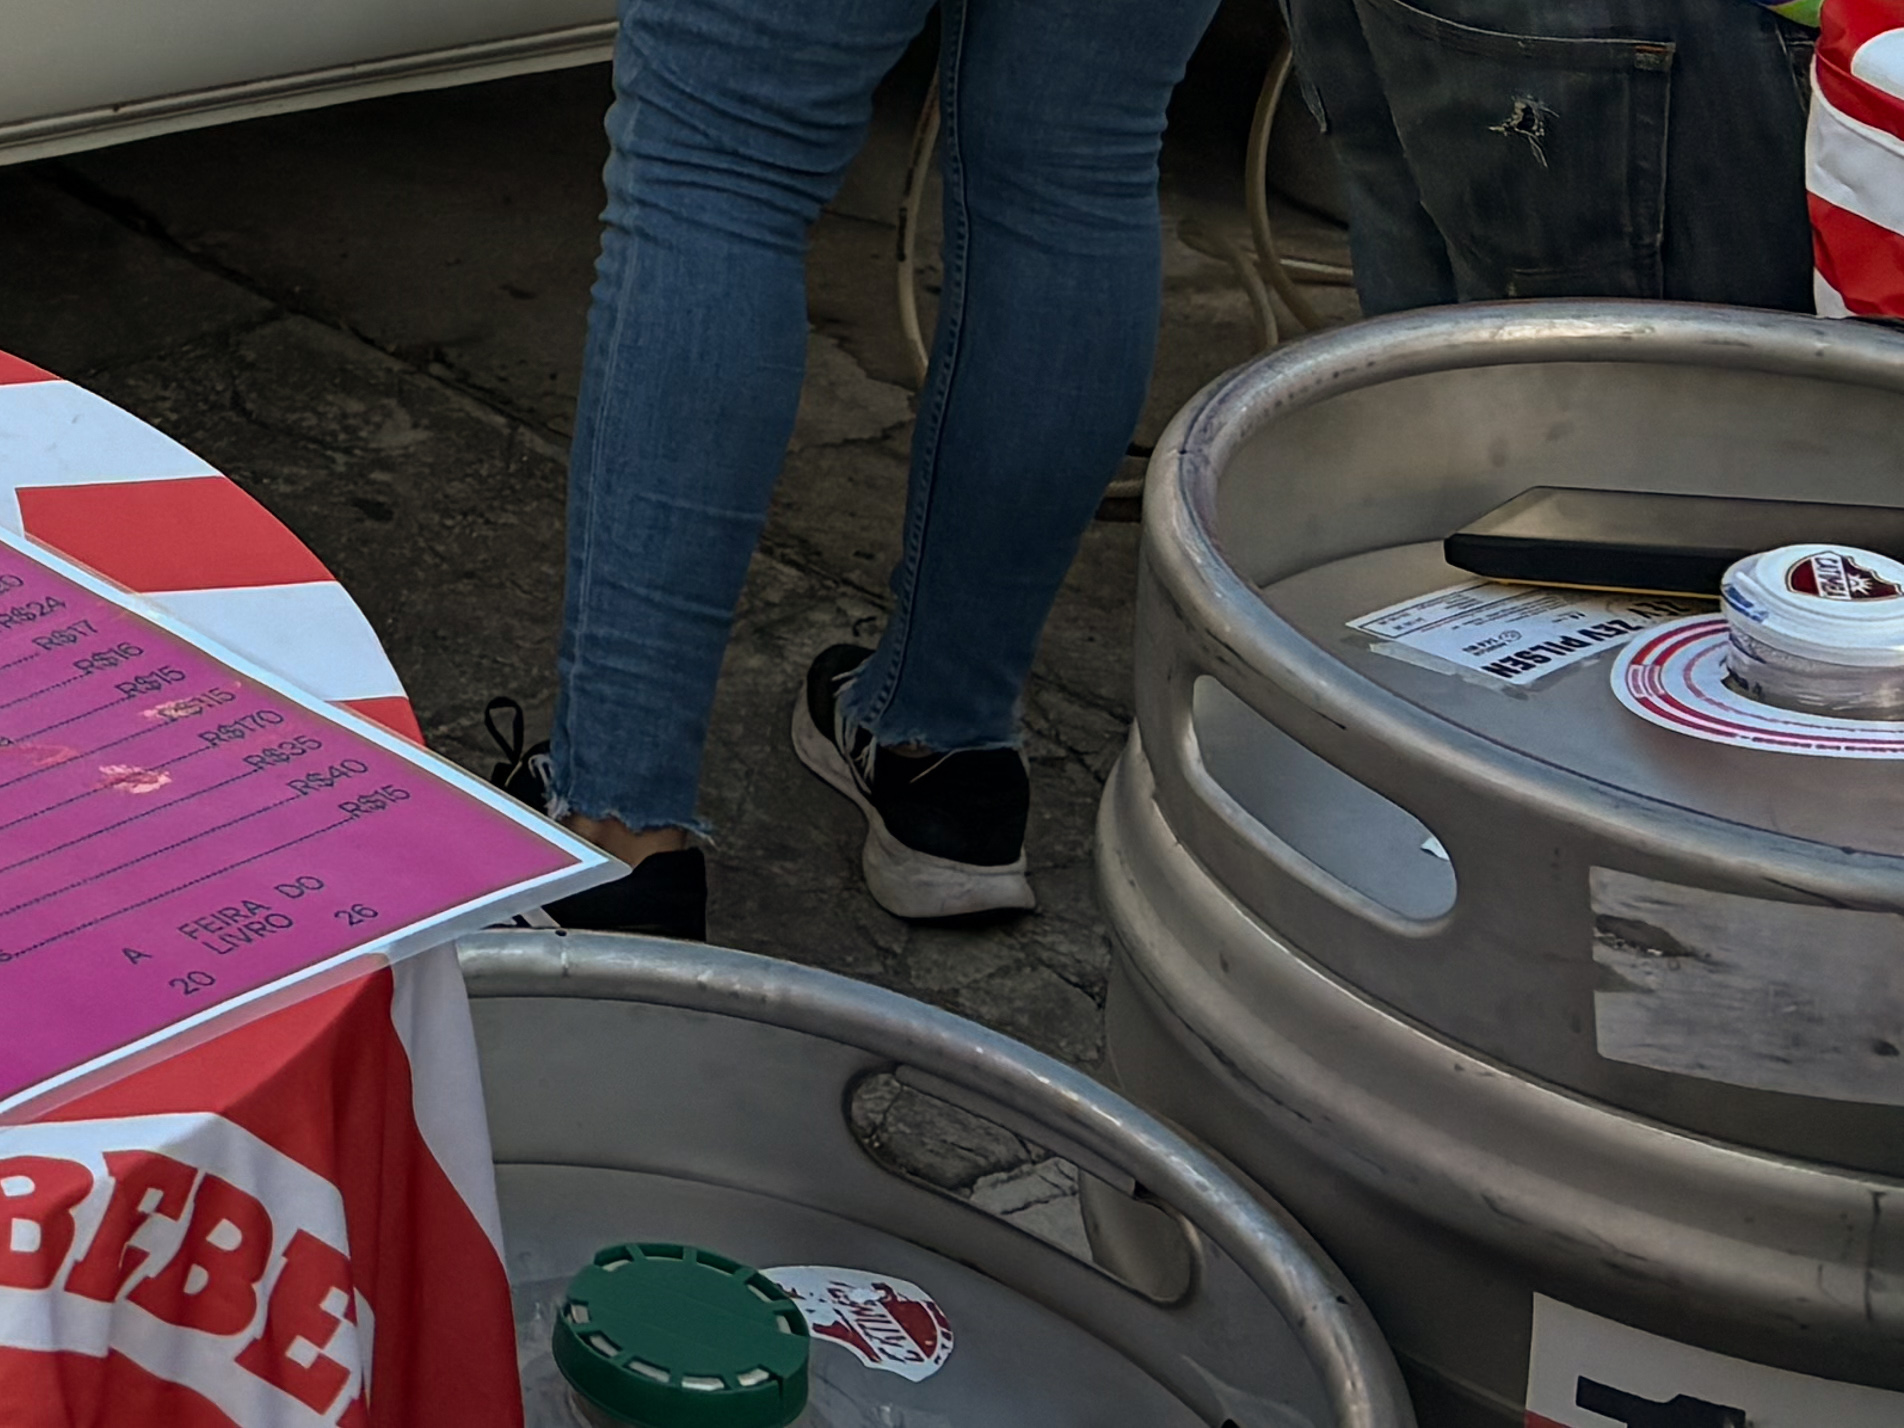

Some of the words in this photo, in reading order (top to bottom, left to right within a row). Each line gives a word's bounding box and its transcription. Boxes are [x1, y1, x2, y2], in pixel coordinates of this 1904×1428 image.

[31, 619, 99, 652] R$17
[73, 642, 145, 675] R$16
[1480, 634, 1580, 679] PILSEN
[114, 665, 186, 698] R$15
[198, 709, 285, 749] R$170
[243, 735, 324, 771] R$35
[286, 759, 369, 796] R$40
[338, 784, 411, 819] R$15
[122, 946, 153, 966] A
[178, 898, 272, 941] FEIRA
[274, 875, 325, 901] DO
[201, 912, 295, 955] LIVRO
[169, 970, 217, 996] 20
[334, 903, 379, 928] 26
